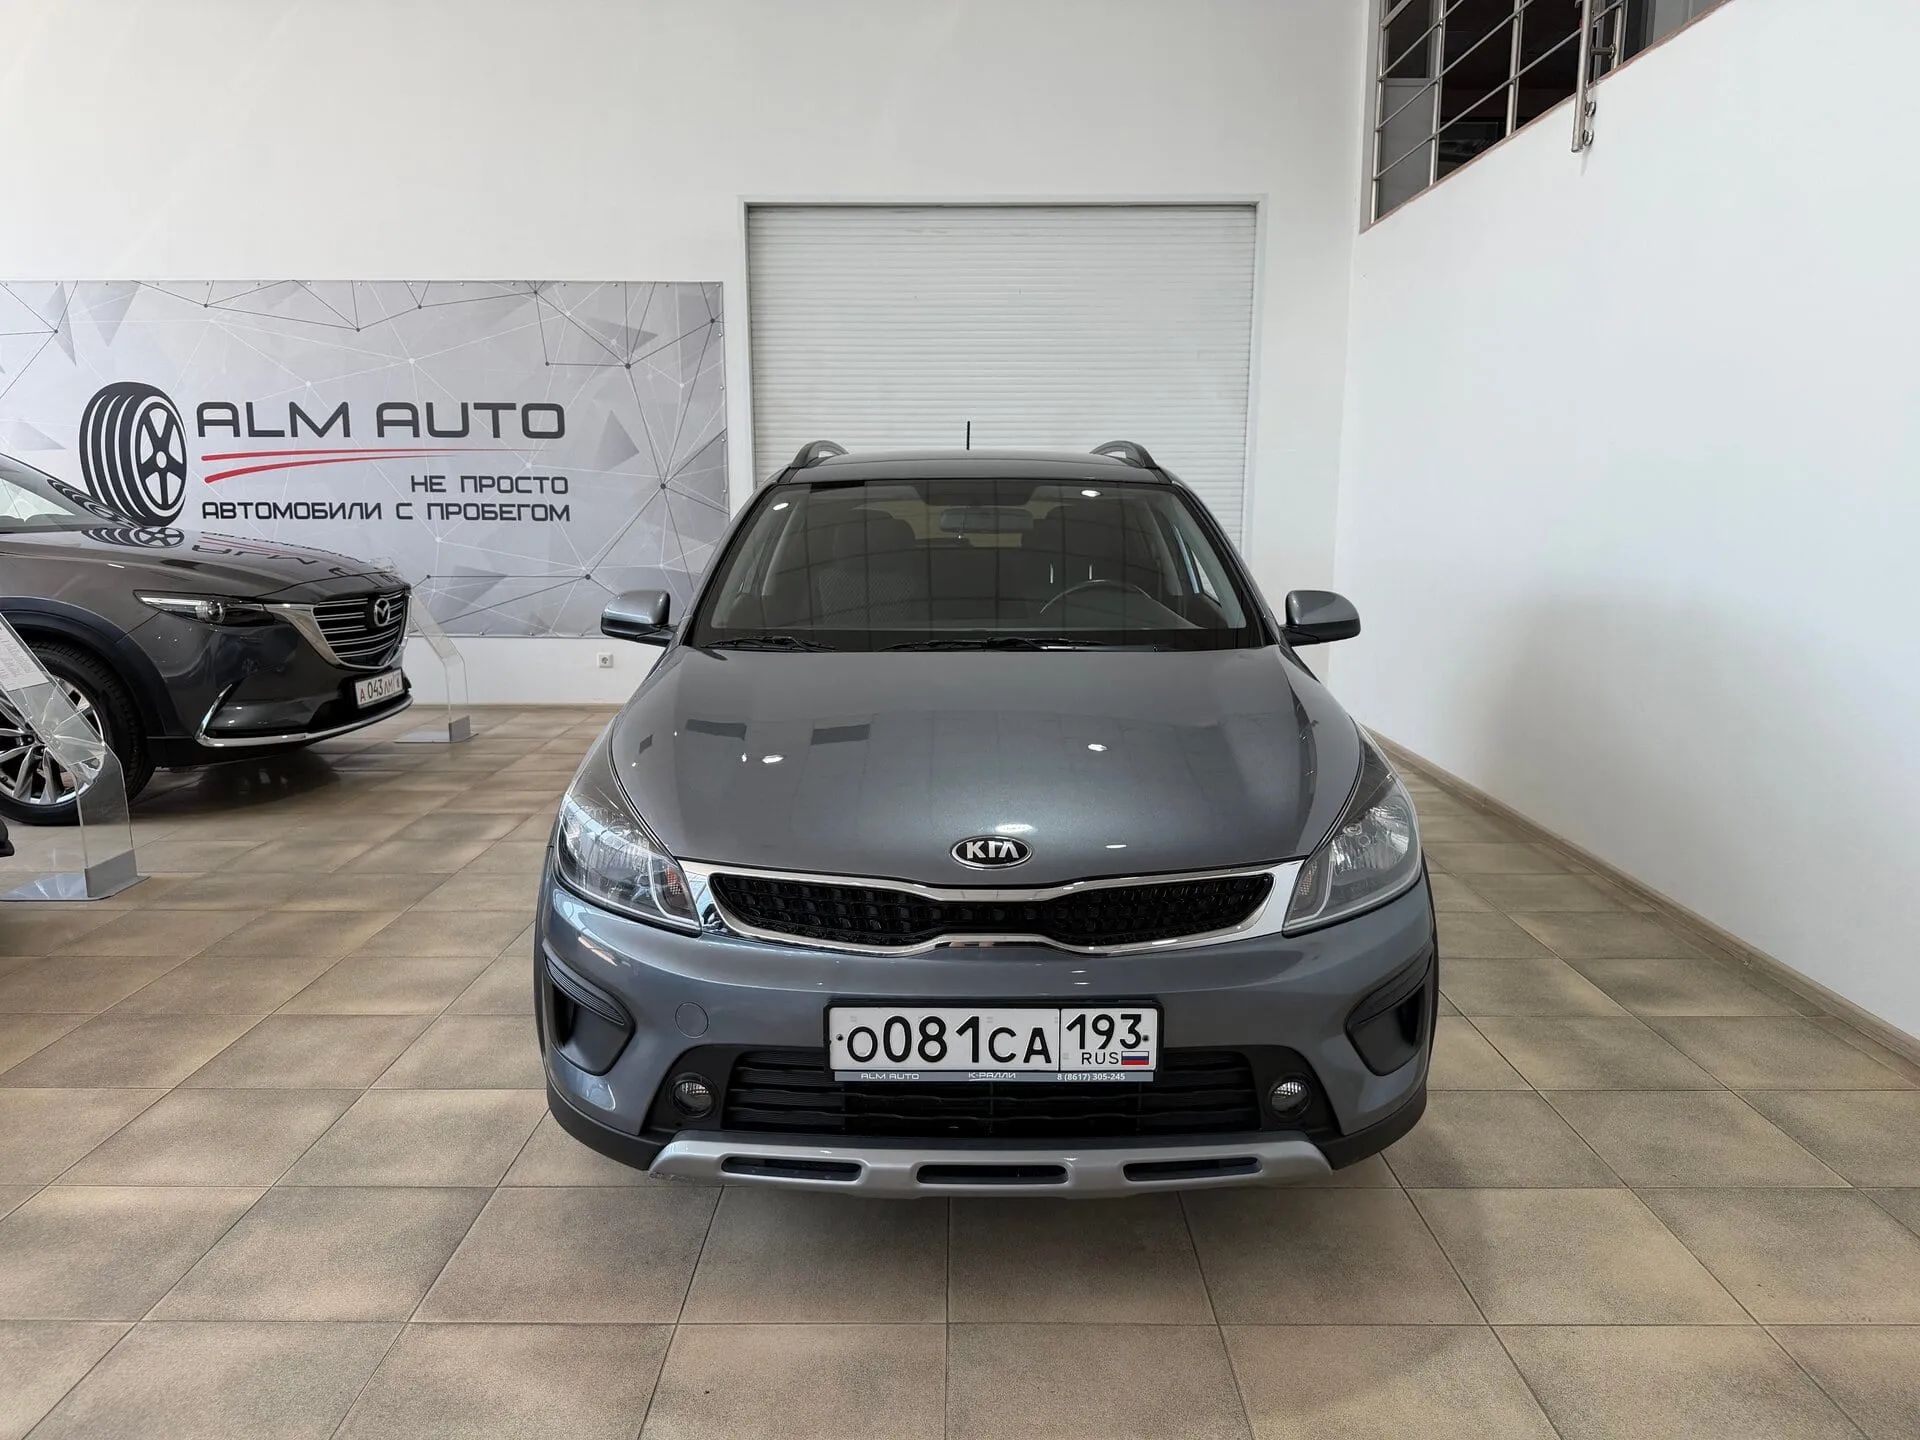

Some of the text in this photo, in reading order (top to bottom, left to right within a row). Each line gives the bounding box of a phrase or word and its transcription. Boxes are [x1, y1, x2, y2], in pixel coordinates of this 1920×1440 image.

[196, 401, 566, 439] ALM AUTO
[411, 475, 569, 494] НЕ ПРОСТО
[202, 501, 570, 522] АВТОМОБИЛИ С ПРОБЕГОМ
[966, 840, 1020, 859] KIA
[1066, 1013, 1142, 1050] 193
[1081, 1051, 1119, 1065] RUS
[860, 1072, 920, 1080] ALM AUTO
[1092, 1072, 1126, 1081] 305-245
